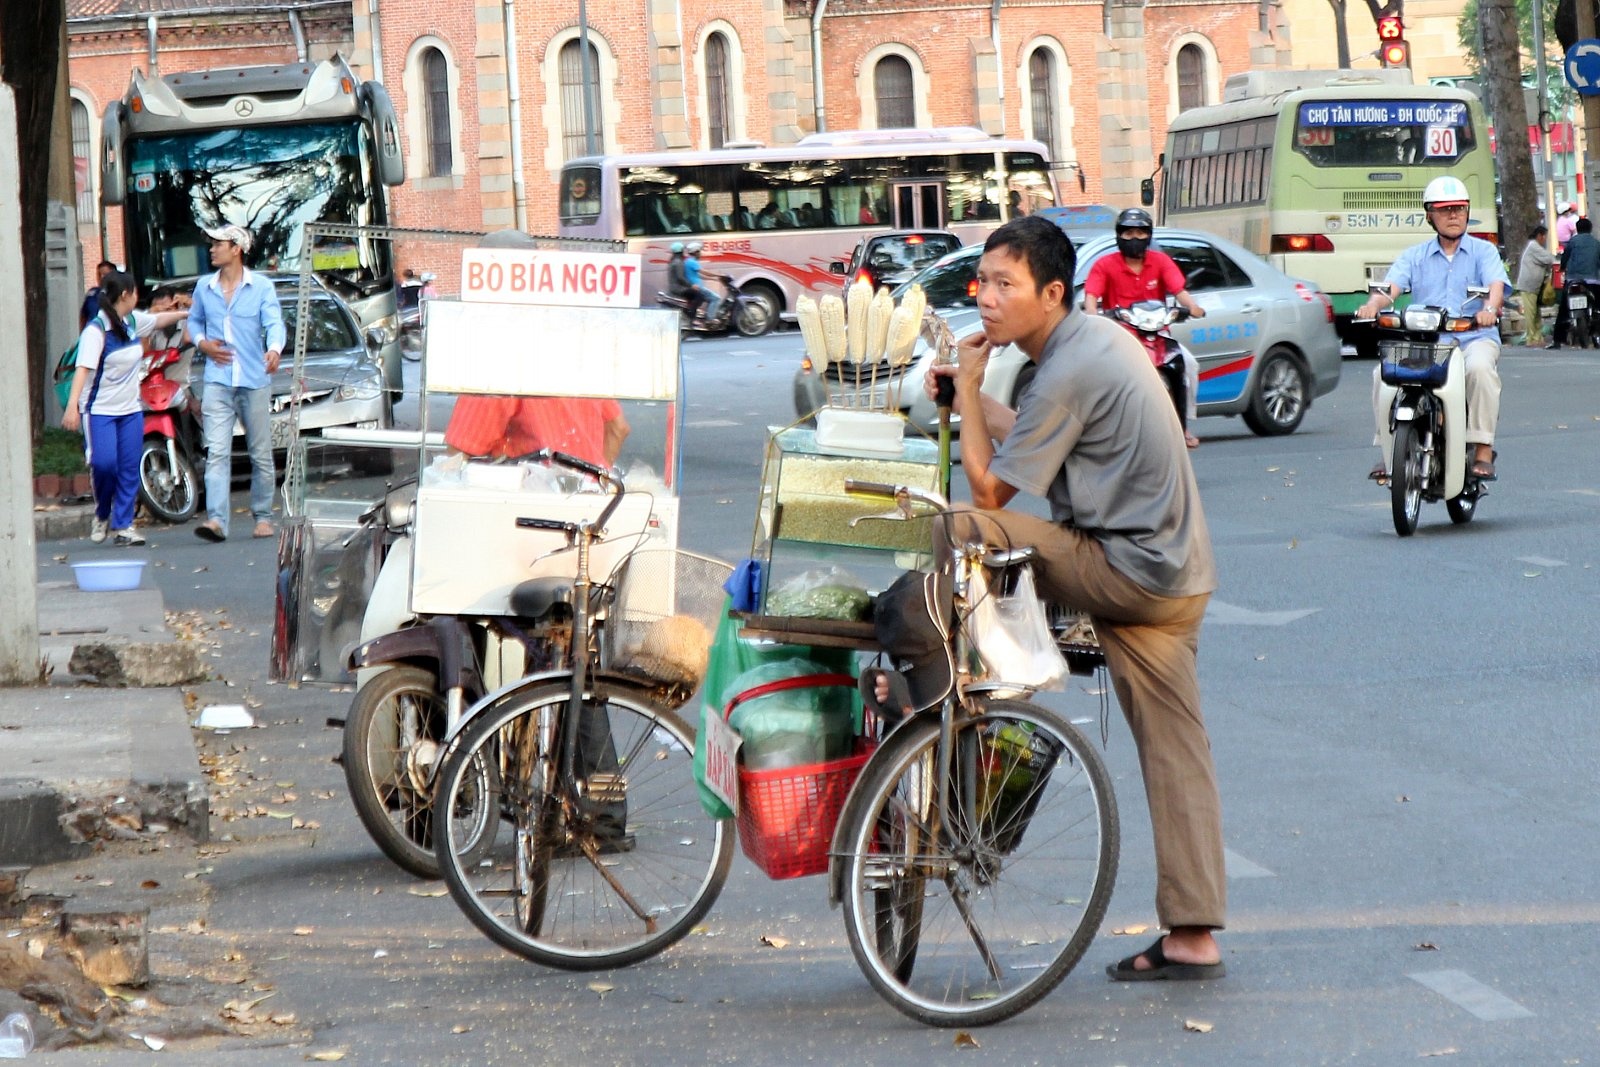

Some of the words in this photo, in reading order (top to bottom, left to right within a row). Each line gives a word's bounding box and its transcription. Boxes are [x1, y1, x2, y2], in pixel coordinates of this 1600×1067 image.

[1308, 107, 1329, 125] CHỢ
[1331, 105, 1351, 123] TÂN
[1354, 106, 1388, 123] HƯƠNG
[1398, 108, 1413, 123] ĐH
[1416, 104, 1442, 124] QUỐC
[1445, 105, 1458, 123] TẾ
[1431, 129, 1453, 155] 30
[468, 255, 503, 292] BÒ
[510, 255, 554, 293] BÍA
[562, 263, 636, 302] NGỌT
